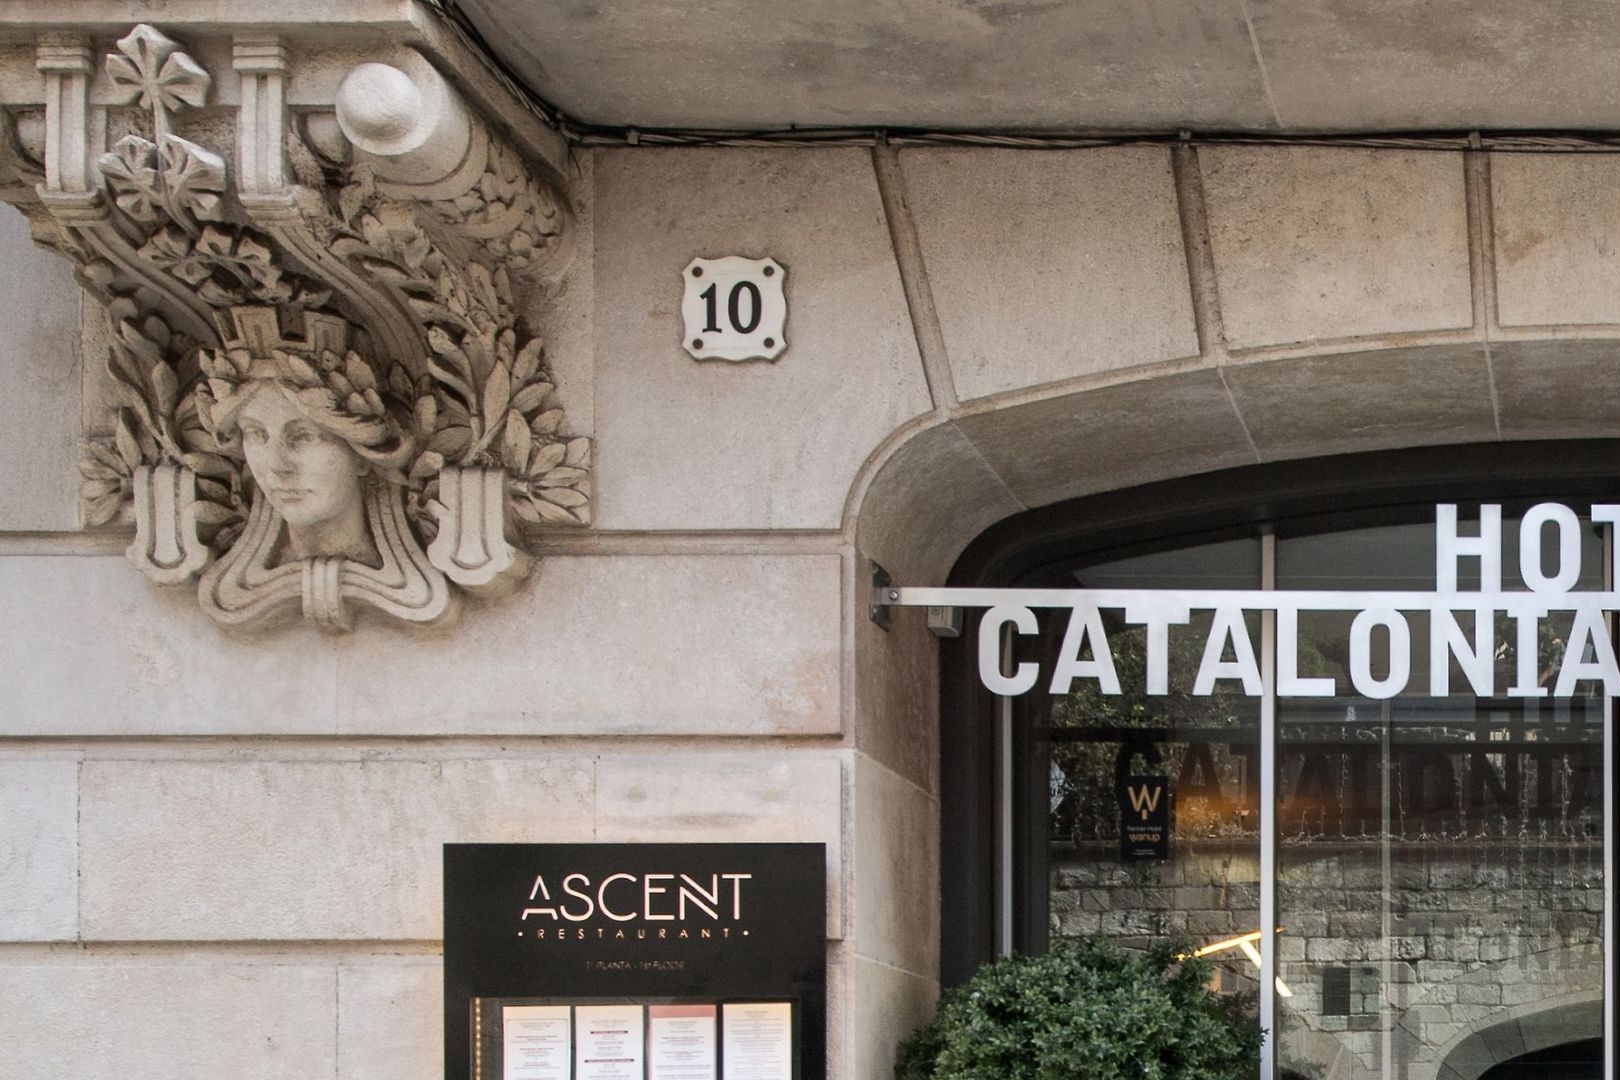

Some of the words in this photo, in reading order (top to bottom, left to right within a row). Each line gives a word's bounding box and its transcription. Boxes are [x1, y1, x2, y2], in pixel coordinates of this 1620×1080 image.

[699, 280, 762, 335] 10
[520, 872, 752, 922] ASCENT
[537, 928, 730, 940] RESTAURANT
